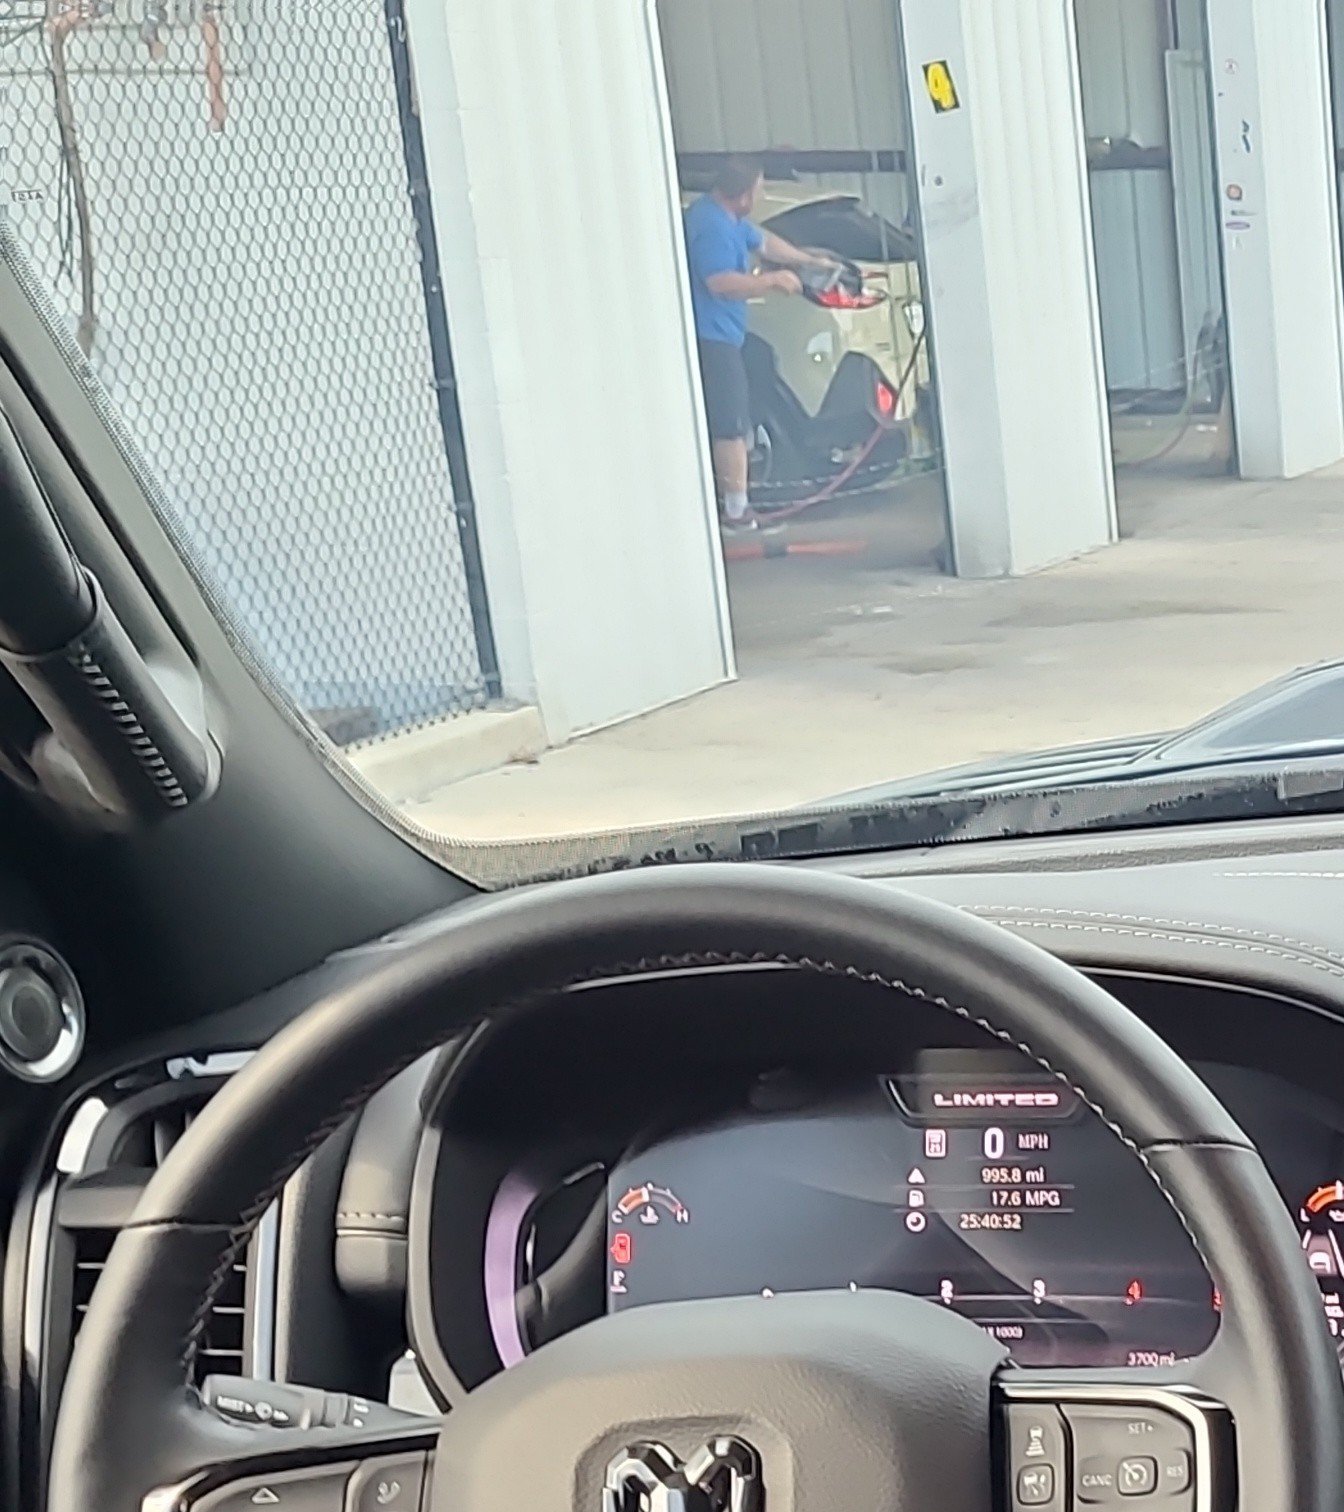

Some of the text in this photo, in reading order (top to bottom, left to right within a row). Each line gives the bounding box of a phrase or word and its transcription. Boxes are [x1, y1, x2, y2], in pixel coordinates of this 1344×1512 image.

[933, 1093, 1059, 1107] LIMITED
[984, 1127, 1049, 1159] 0 MPH
[982, 1167, 1045, 1183] 995.8 mi
[992, 1191, 1061, 1206] 17.6 MPG
[960, 1214, 1022, 1230] 25:40:52
[1082, 1474, 1112, 1487] CANC
